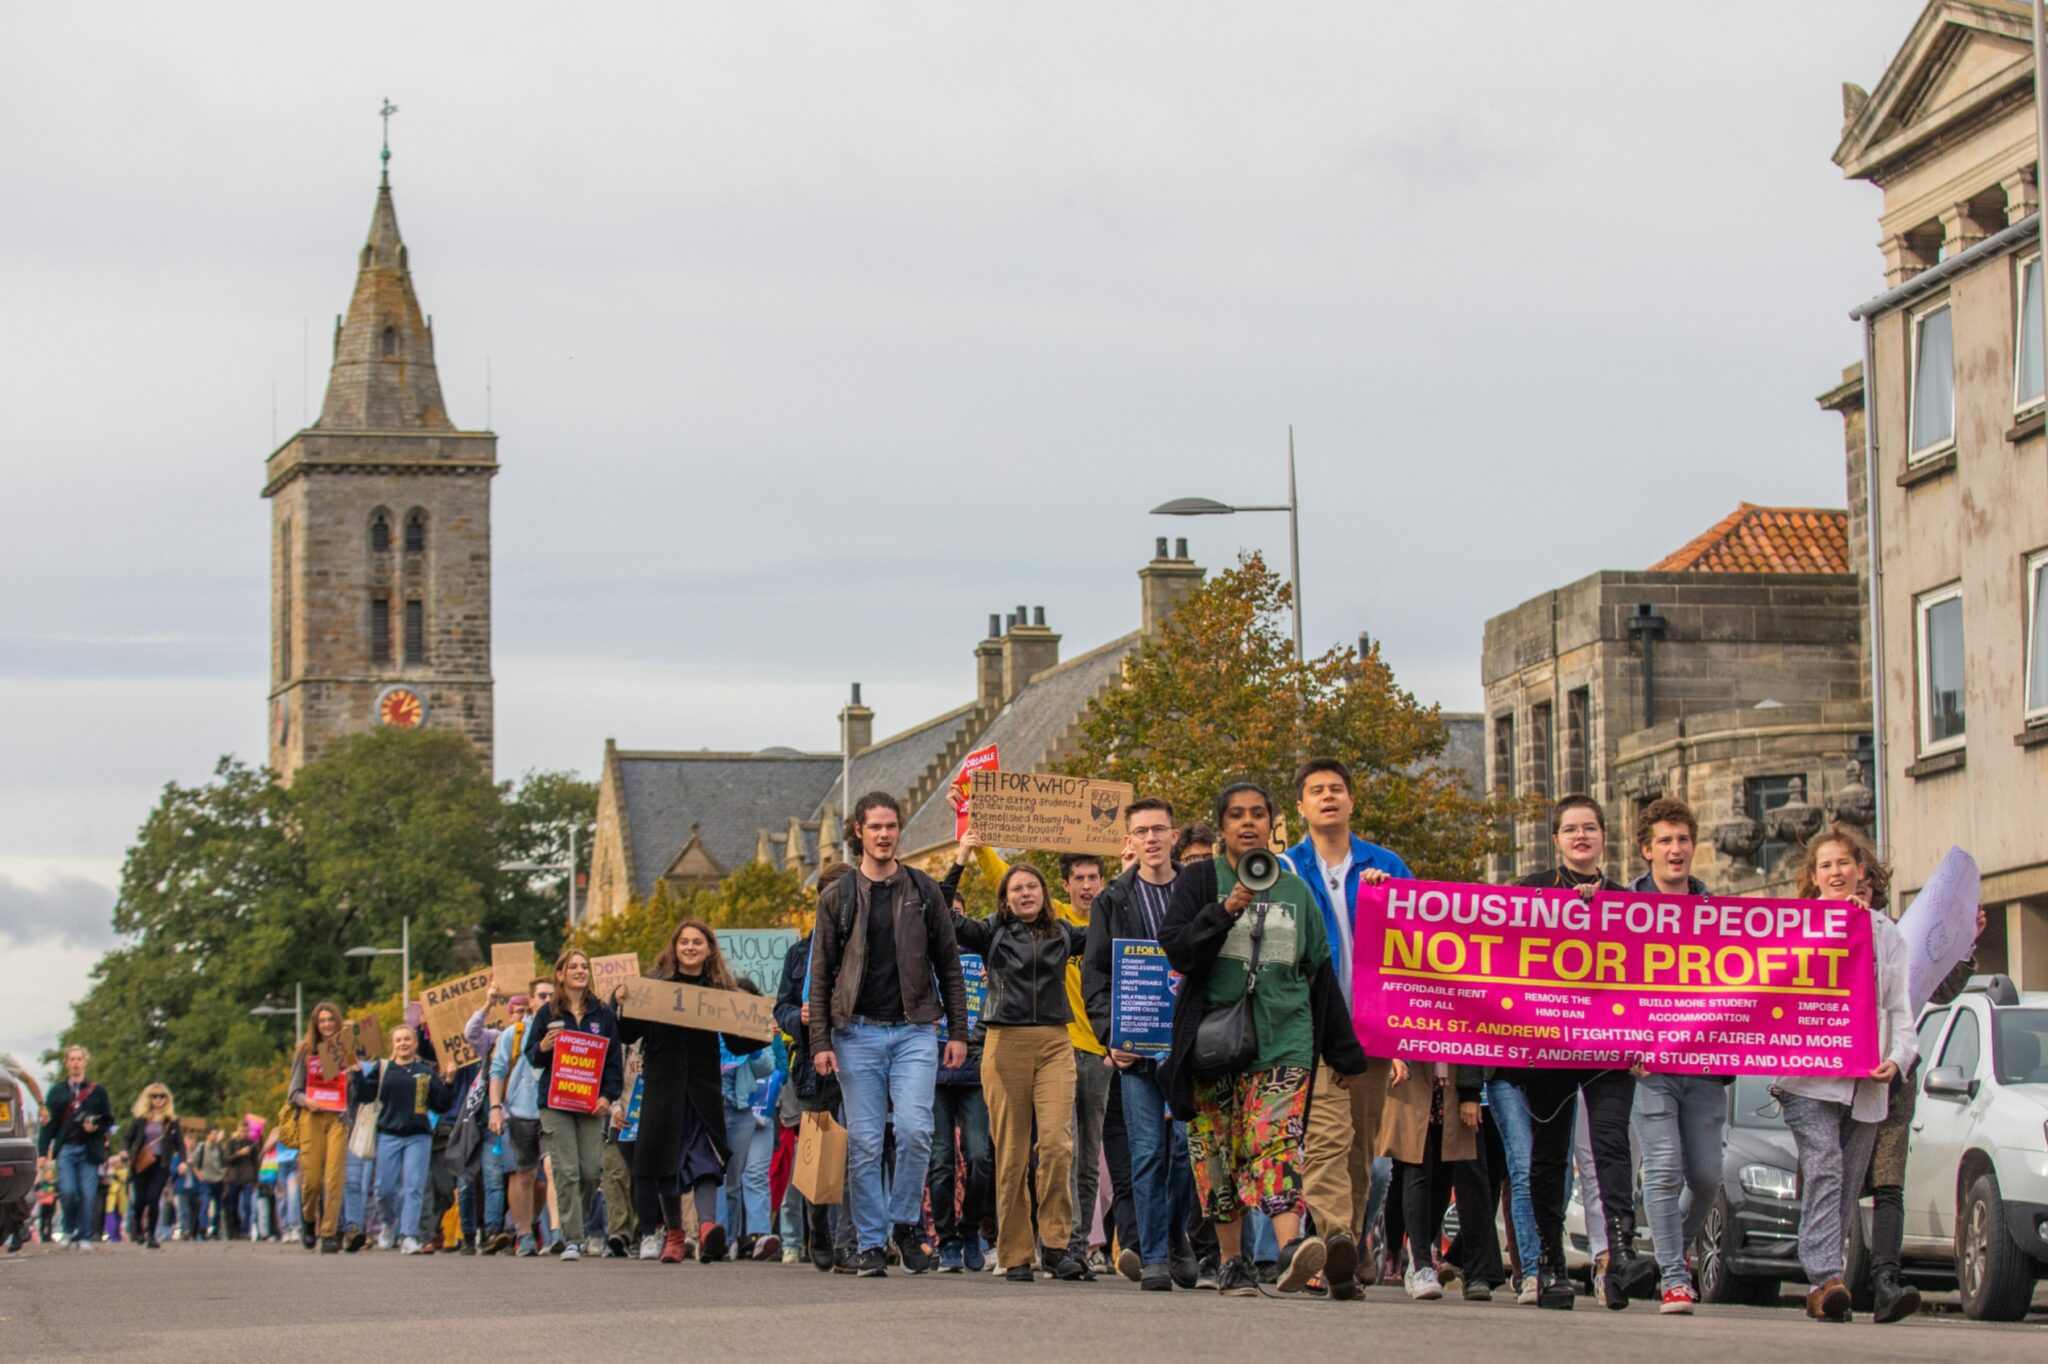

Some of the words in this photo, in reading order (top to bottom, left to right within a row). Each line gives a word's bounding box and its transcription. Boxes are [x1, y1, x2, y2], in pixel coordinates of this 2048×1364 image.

[973, 771, 996, 792] #1
[1001, 773, 1030, 792] FOR
[1033, 776, 1089, 799] WHO?
[1006, 795, 1036, 806] extra
[1005, 804, 1035, 814] housing
[975, 811, 1030, 822] Demolished
[1027, 824, 1064, 835] housing
[1386, 888, 1591, 931] HOUSING
[1601, 901, 1682, 934] FOR
[1693, 905, 1847, 939] PEOPLE
[1137, 946, 1155, 954] FOR
[1383, 928, 1504, 975] NOT
[1519, 937, 1627, 982] FOR
[1643, 943, 1849, 987] PROFIT
[427, 975, 487, 1006] RANKED
[1382, 982, 1455, 997] AFFORDABLE
[1458, 988, 1487, 999] RENT
[698, 991, 727, 1019] For
[1409, 998, 1432, 1009] FOR
[1434, 1000, 1455, 1011] ALL
[1525, 992, 1569, 1005] REMOVE
[1571, 995, 1592, 1005] THE
[1639, 998, 1672, 1008] BUILD
[1674, 998, 1707, 1008] MORE
[1708, 999, 1758, 1008] STUDENT
[1798, 1001, 1839, 1012] IMPOSE
[1841, 1003, 1850, 1012] A
[1536, 1008, 1560, 1018] HMO
[1562, 1009, 1585, 1019] BAN
[1648, 1012, 1750, 1023] ACCOMMODATION
[1798, 1016, 1824, 1026] RENT
[1827, 1017, 1850, 1027] CAP
[1387, 1015, 1443, 1032] C.A.S.H.
[1447, 1020, 1472, 1034] ST.
[1476, 1022, 1561, 1039] ANDREWS
[1572, 1028, 1654, 1042] FIGHTING
[1658, 1030, 1691, 1043] FOR
[1694, 1031, 1705, 1043] A
[1708, 1031, 1765, 1045] FAIRER
[1769, 1033, 1802, 1047] AND
[1806, 1035, 1853, 1048] MORE
[559, 1034, 605, 1050] AFFORDABLE
[571, 1045, 589, 1055] RENT
[1397, 1038, 1504, 1058] AFFORDABLE
[1508, 1046, 1532, 1060] ST.
[1536, 1048, 1619, 1062] ANDREWS
[1624, 1050, 1655, 1064] FOR
[1659, 1052, 1740, 1066] STUDENTS
[1744, 1055, 1777, 1067] AND
[1781, 1056, 1843, 1069] LOCALS
[561, 1053, 596, 1070] NOW!
[558, 1080, 593, 1096] NOW!
